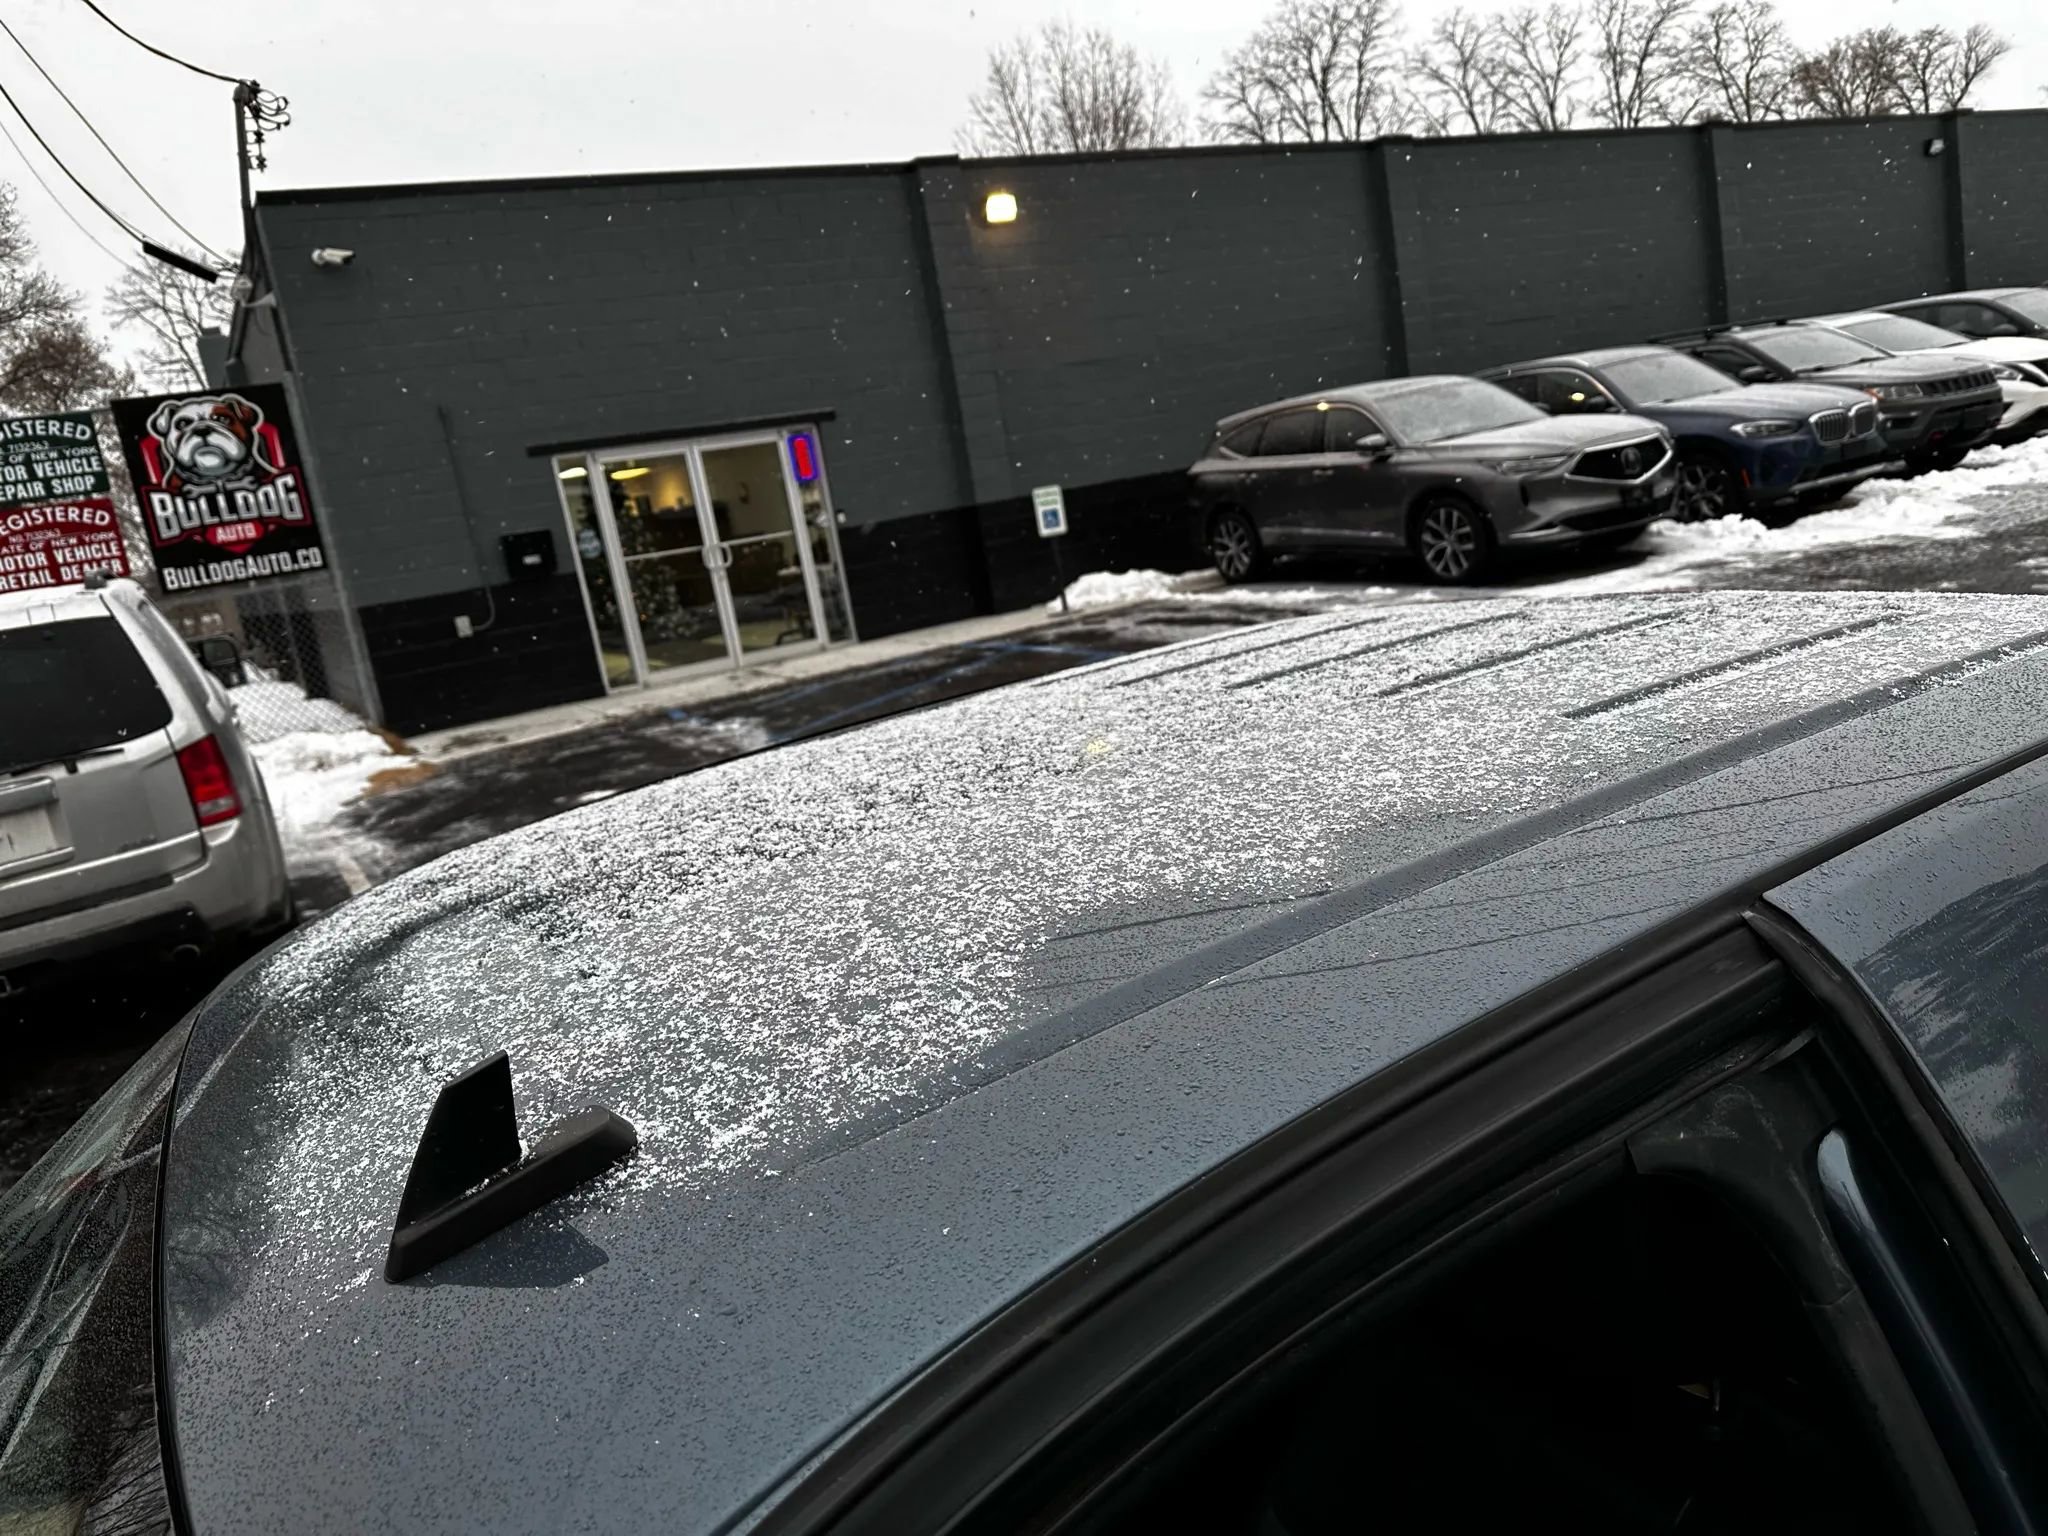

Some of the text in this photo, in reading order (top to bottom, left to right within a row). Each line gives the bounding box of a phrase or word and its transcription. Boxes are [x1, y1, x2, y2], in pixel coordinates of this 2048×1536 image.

[8, 453, 26, 464] OF
[30, 450, 58, 461] NEW
[62, 446, 98, 457] YORK
[33, 456, 103, 478] VEHICLE
[51, 474, 95, 495] SHOP
[149, 473, 304, 540] BULLDOG
[29, 542, 45, 551] OF
[51, 536, 78, 547] NEW
[82, 530, 118, 542] YORK
[215, 521, 258, 543] AUTO
[53, 540, 122, 564] VEHICLE
